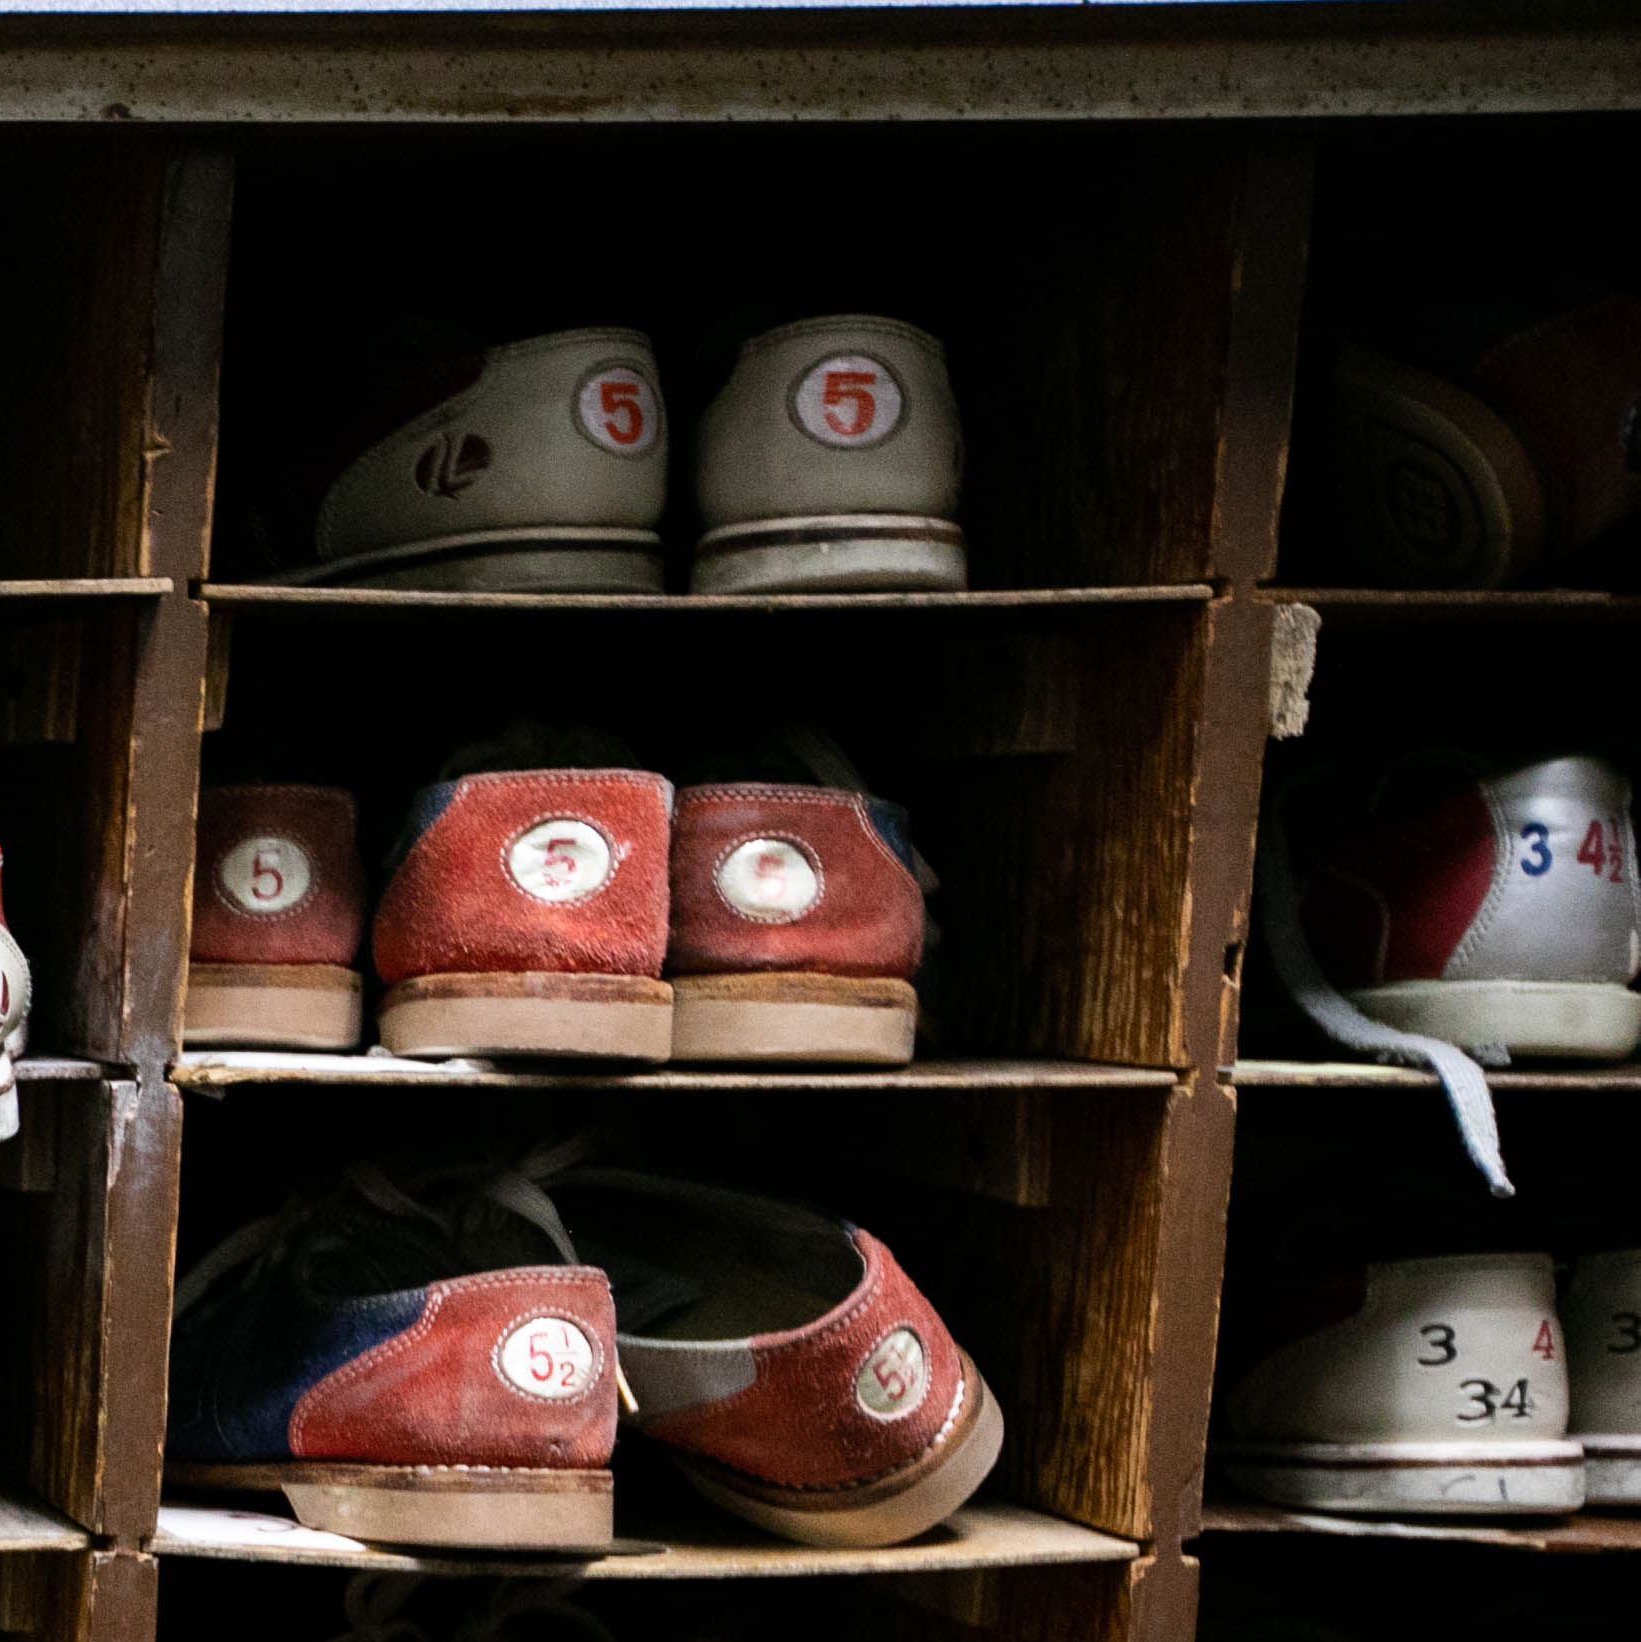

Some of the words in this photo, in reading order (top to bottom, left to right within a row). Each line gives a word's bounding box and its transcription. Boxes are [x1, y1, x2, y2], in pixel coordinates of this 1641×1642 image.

[601, 383, 642, 445] 5
[822, 372, 877, 436] 5
[251, 846, 284, 901] 5
[1521, 823, 1552, 876] 3
[1418, 1324, 1457, 1366] 3
[1533, 1319, 1554, 1360] 4
[1608, 1313, 1640, 1353] 3
[1458, 1378, 1535, 1421] 34
